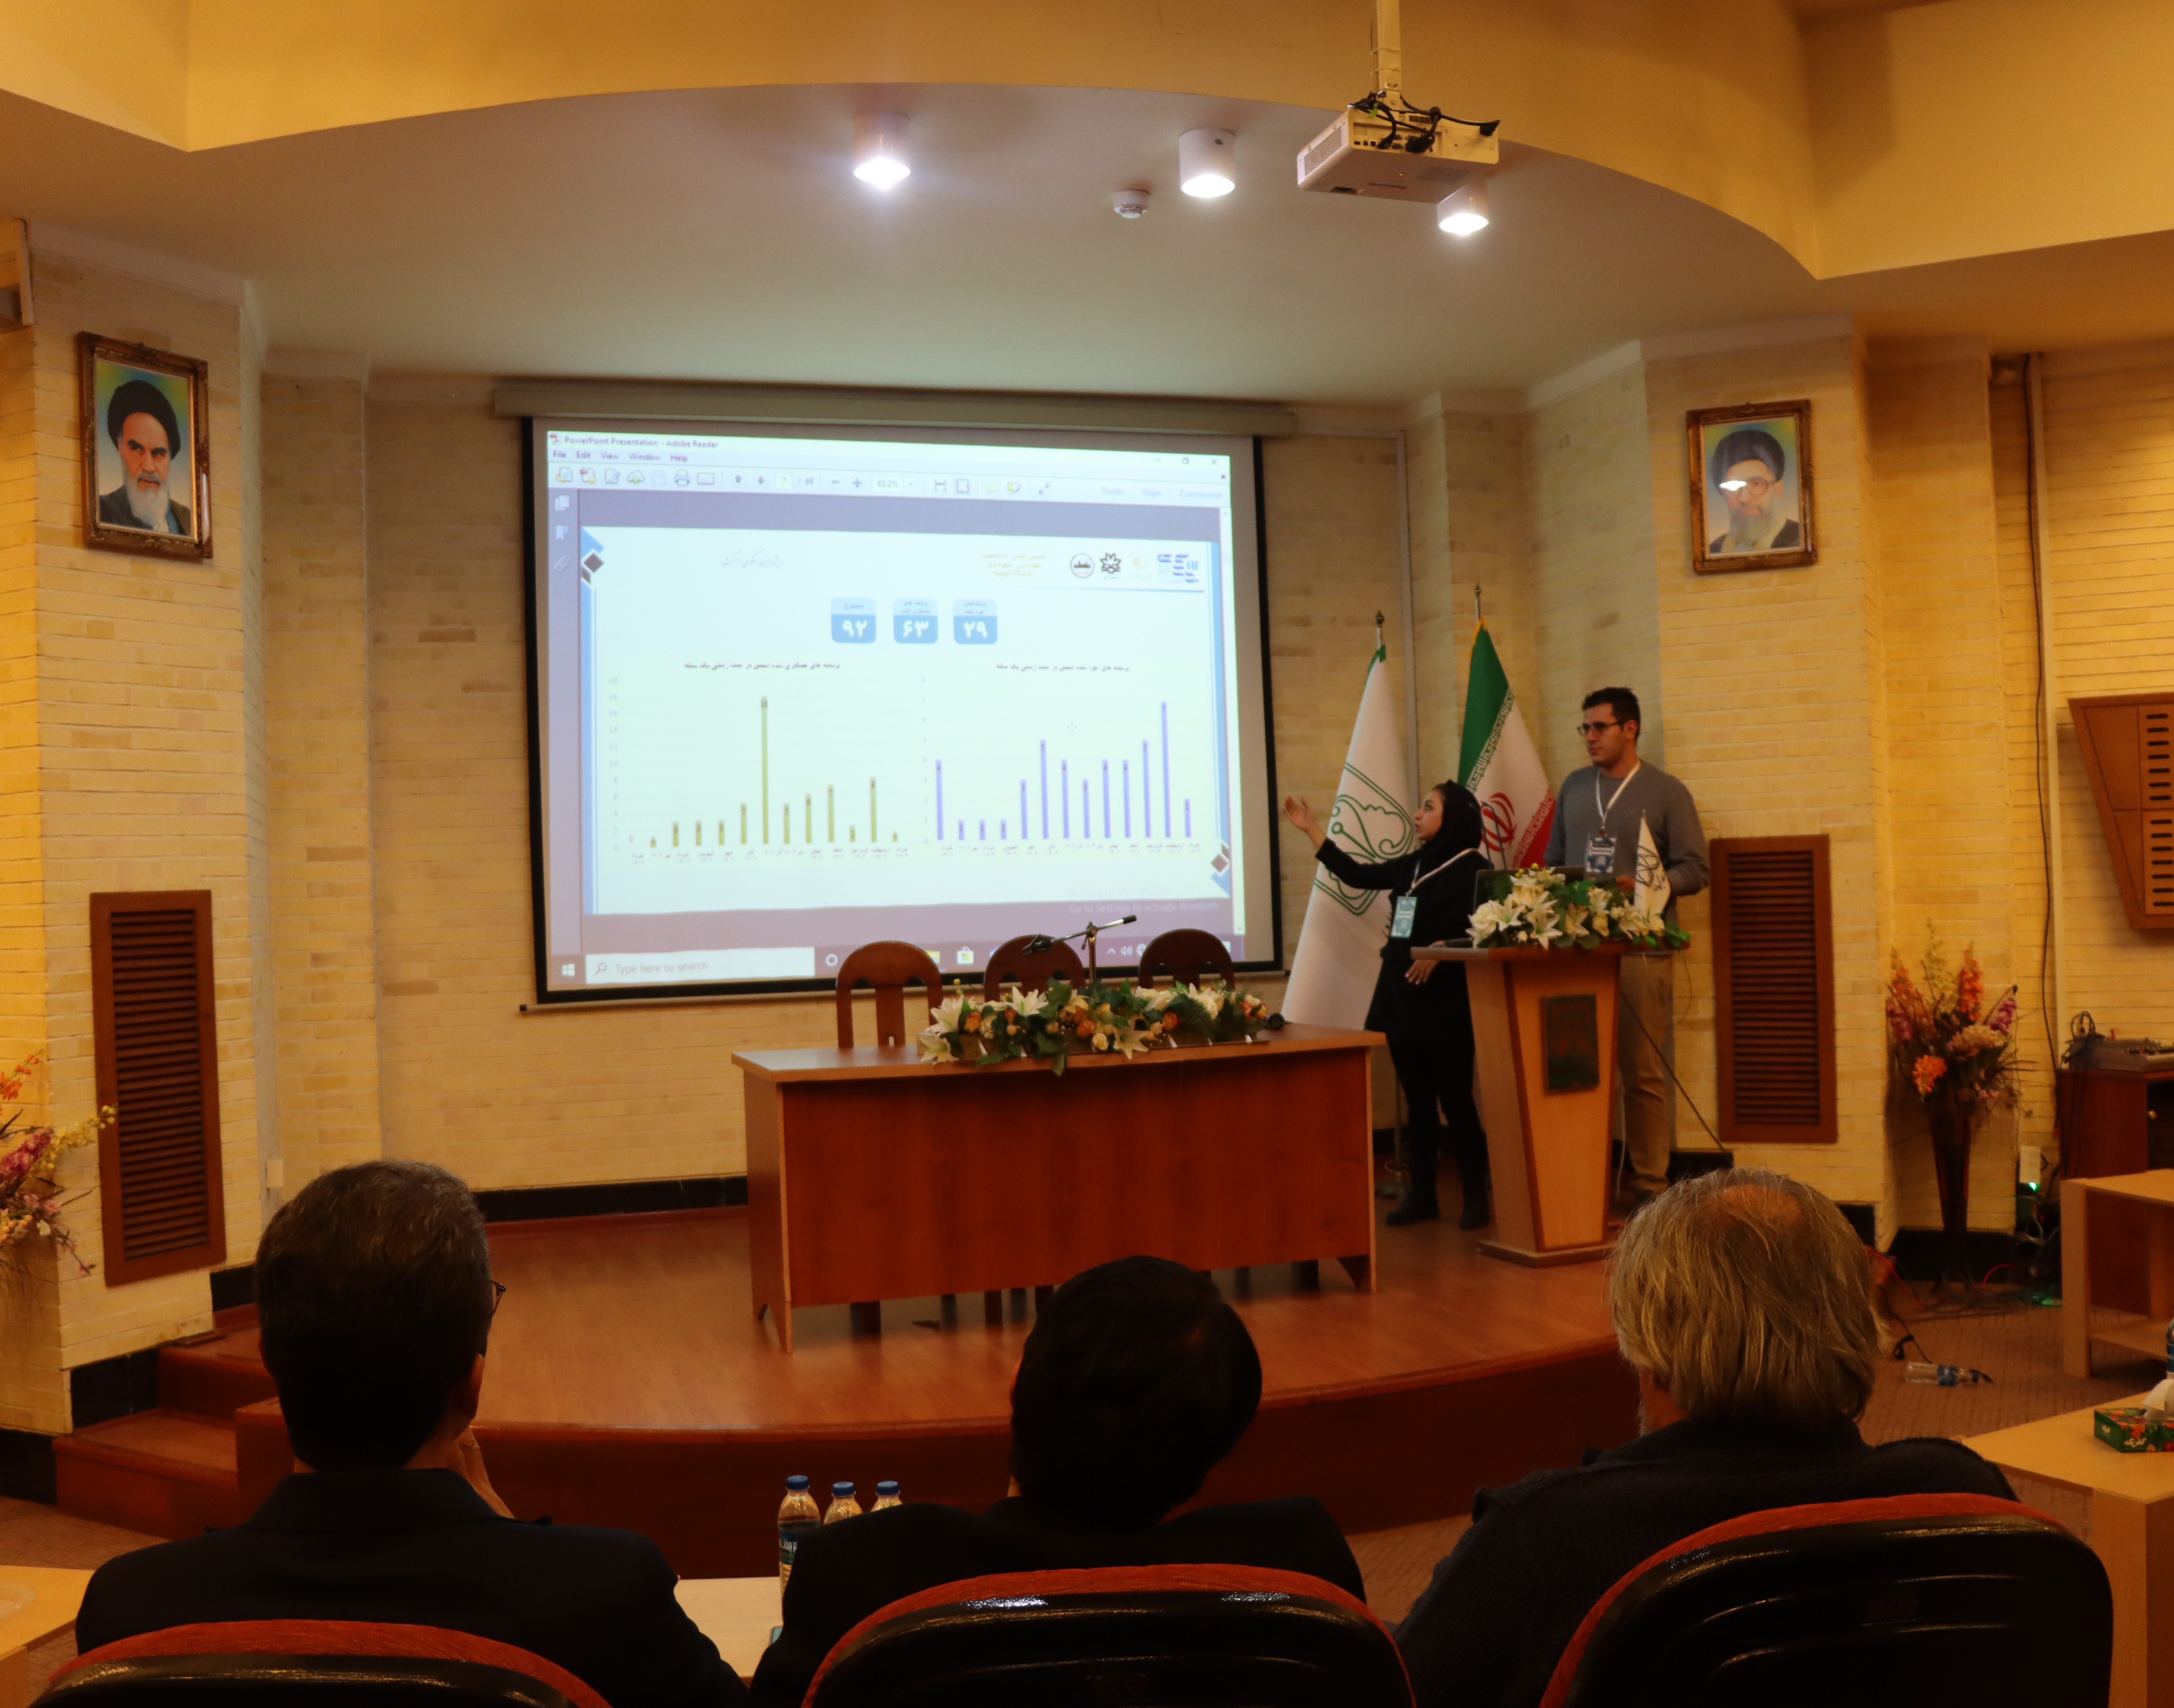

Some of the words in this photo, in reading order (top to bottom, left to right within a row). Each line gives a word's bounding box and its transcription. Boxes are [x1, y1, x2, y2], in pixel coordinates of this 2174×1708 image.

[565, 436, 609, 445] PowerPoint
[612, 437, 658, 446] Presentation
[577, 451, 591, 459] Edit
[601, 451, 619, 459] View
[670, 454, 688, 462] Help
[1101, 487, 1125, 495] Tools
[1142, 488, 1162, 498] Sign
[1179, 490, 1222, 498] Comment
[842, 620, 868, 638] ۹۲
[903, 620, 930, 638] ۶۳
[963, 621, 988, 639] ۲۹
[1069, 887, 1115, 899] Activate
[1118, 887, 1170, 897] Windows
[1069, 904, 1081, 913] Go
[1084, 904, 1093, 913] to
[1096, 903, 1131, 914] Settings
[1144, 903, 1177, 911] activate
[616, 964, 637, 975] Type
[640, 964, 661, 973] here
[664, 964, 674, 972] to
[677, 961, 708, 971] search
